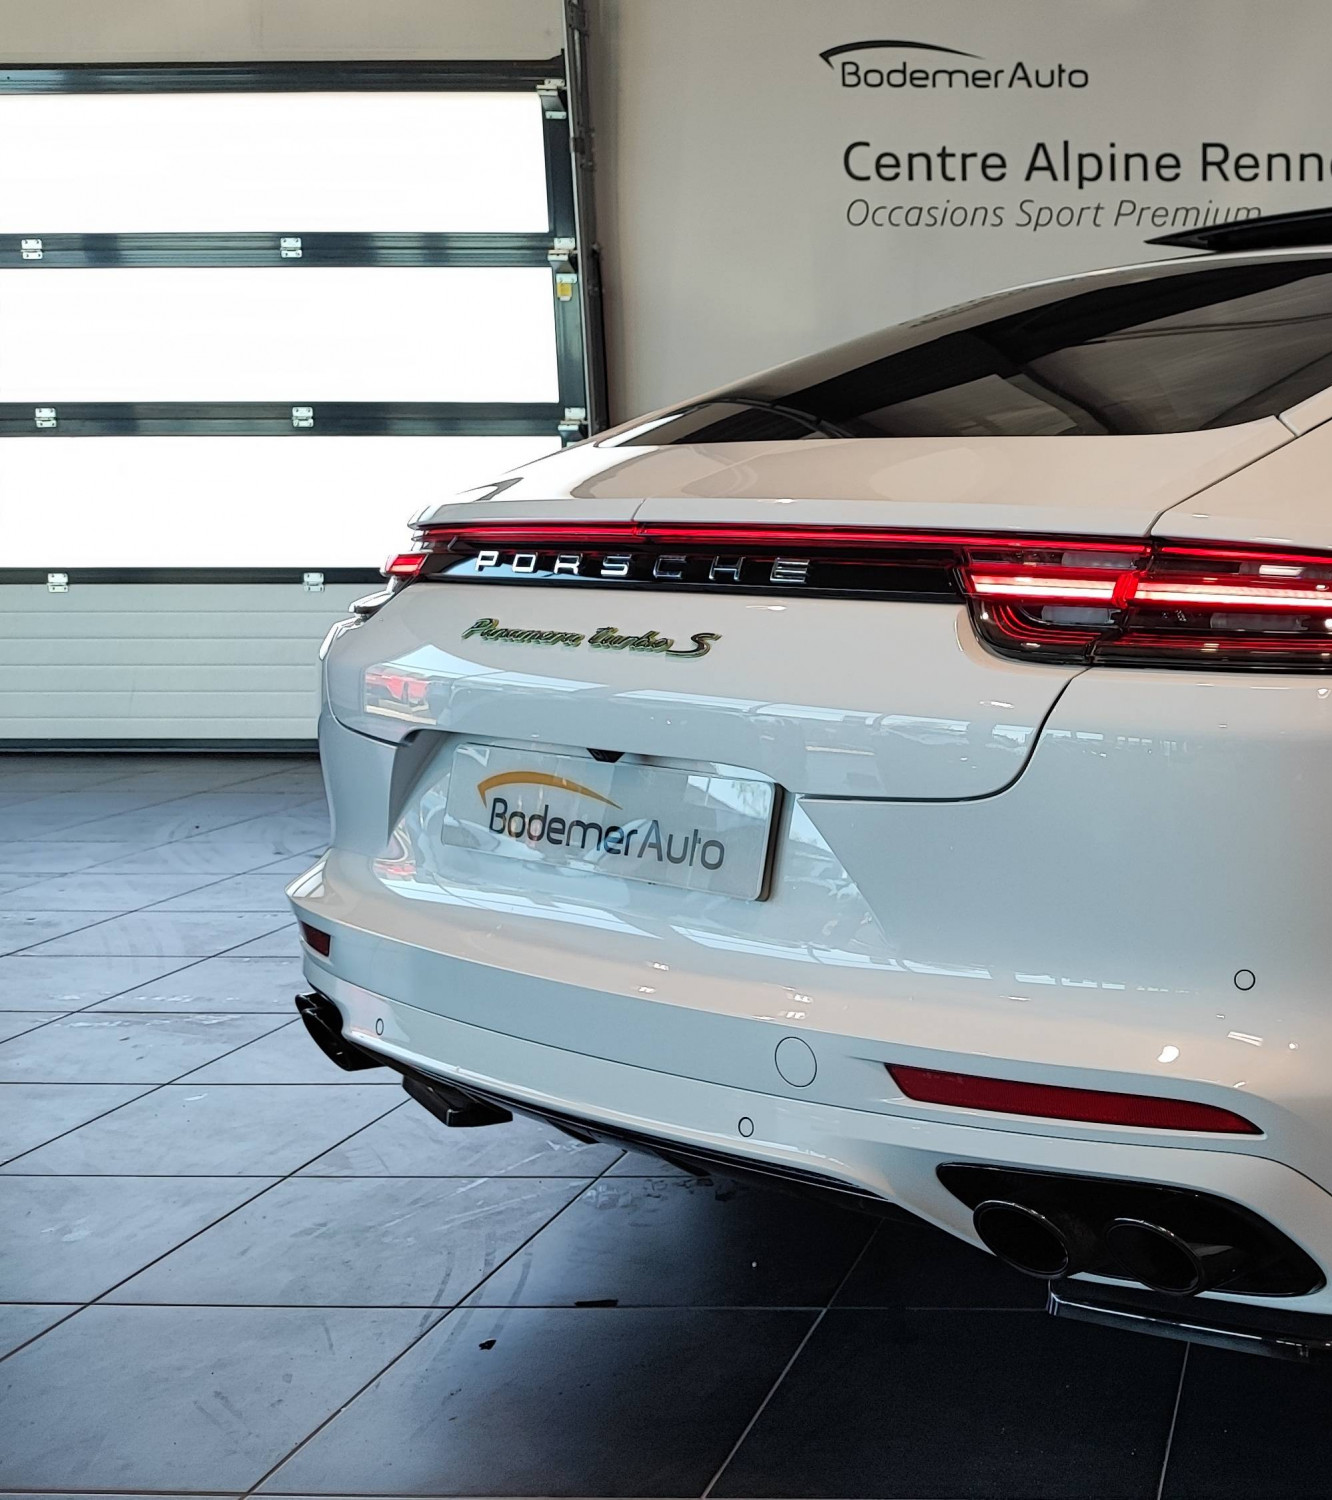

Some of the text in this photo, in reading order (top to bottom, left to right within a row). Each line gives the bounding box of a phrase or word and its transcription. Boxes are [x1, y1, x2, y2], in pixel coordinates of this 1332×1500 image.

[843, 142, 1008, 182] Centre
[1024, 141, 1182, 189] Alpine
[846, 199, 1005, 228] Occasions
[1015, 199, 1105, 231] Sport
[475, 550, 811, 585] PORSCHE
[664, 632, 723, 659] S
[489, 797, 726, 871] BodemerAuto
